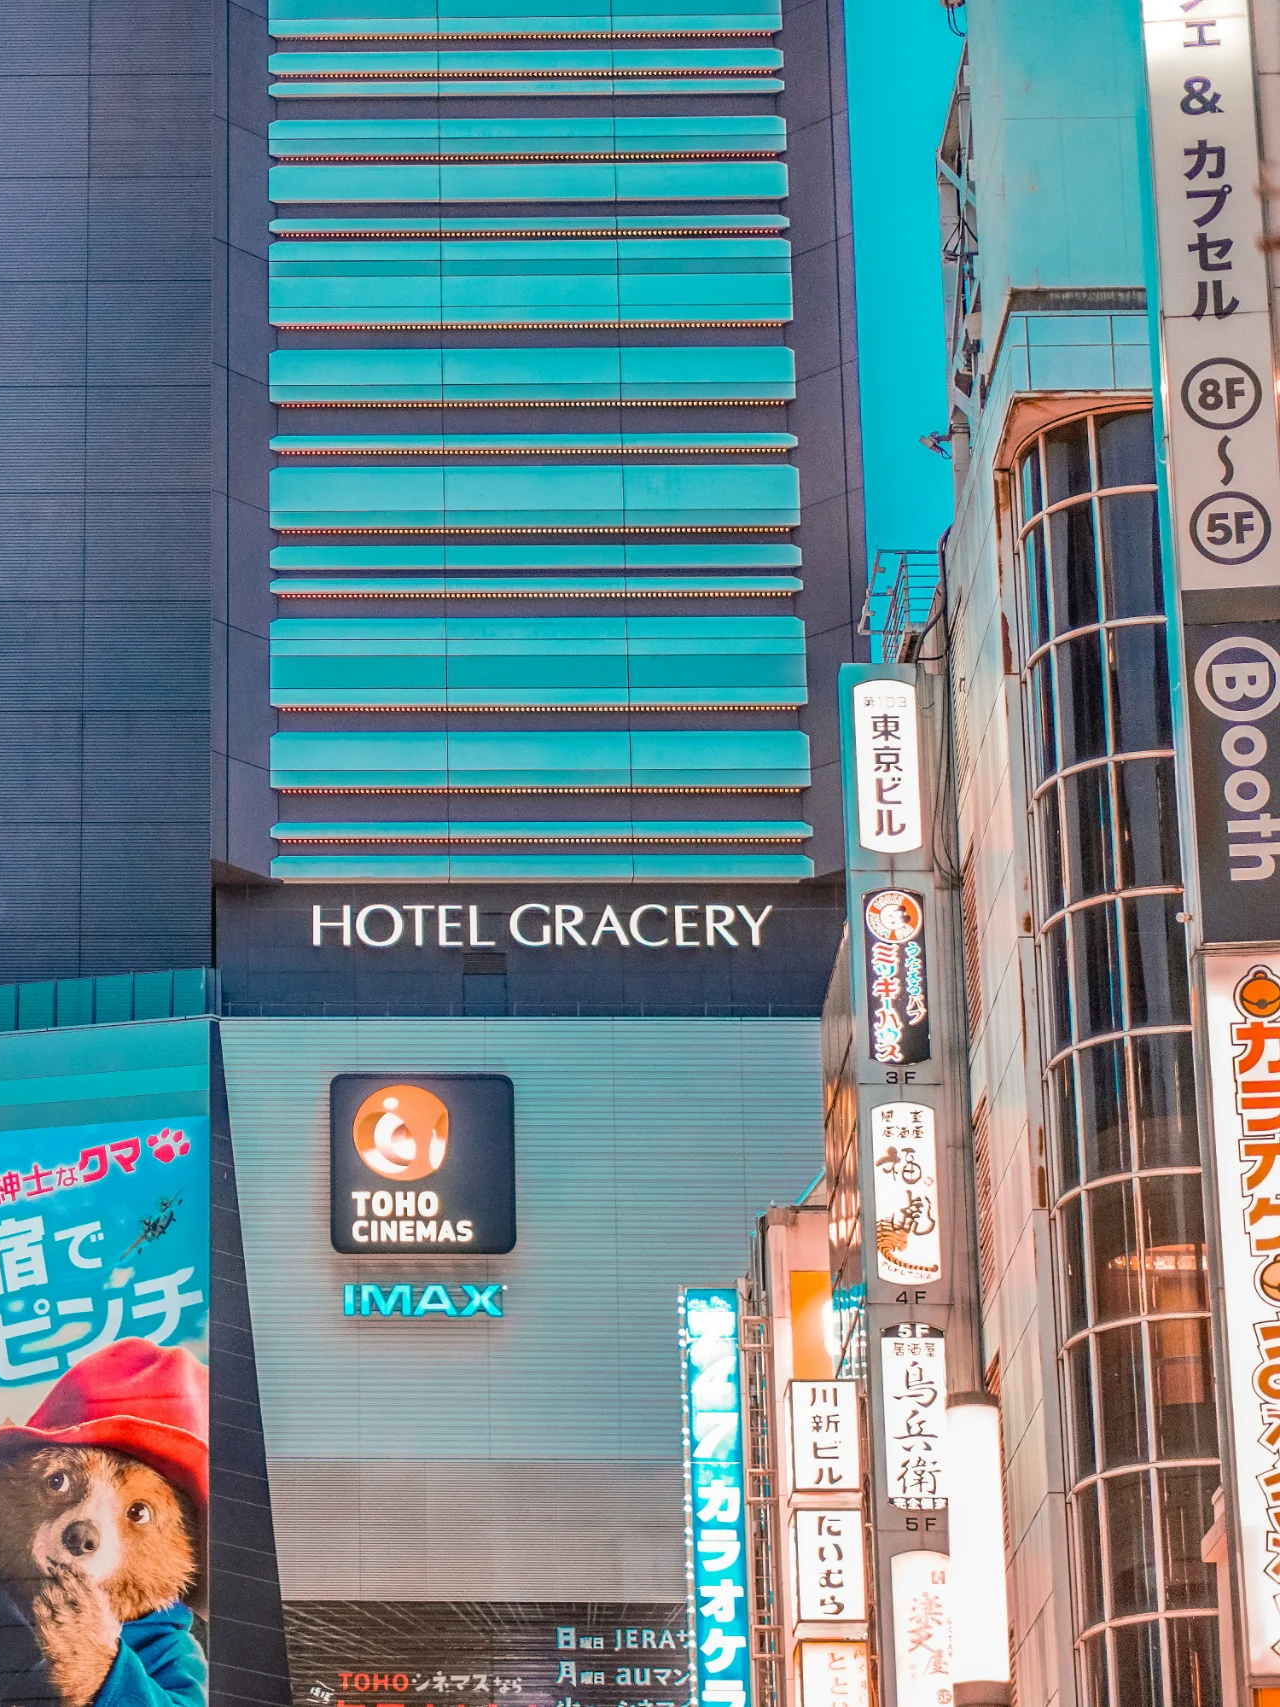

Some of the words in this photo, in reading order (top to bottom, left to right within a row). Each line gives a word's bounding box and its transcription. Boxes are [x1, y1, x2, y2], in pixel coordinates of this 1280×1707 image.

[1197, 376, 1247, 411] 8F
[1206, 511, 1255, 546] 5F
[870, 713, 906, 837] 東京ビル
[311, 904, 497, 947] HOTEL
[509, 903, 773, 947] GRACERY
[871, 943, 904, 1062] ミッキーハウス
[886, 1071, 916, 1084] 3F
[351, 1191, 438, 1217] TOHO
[351, 1221, 473, 1243] CINEMAS
[343, 1284, 504, 1318] IMAX
[896, 1291, 926, 1305] 4F
[898, 1325, 930, 1338] 5F
[810, 1387, 843, 1485] 川新ビル
[906, 1518, 937, 1531] 5F
[817, 1515, 845, 1615] にいむら
